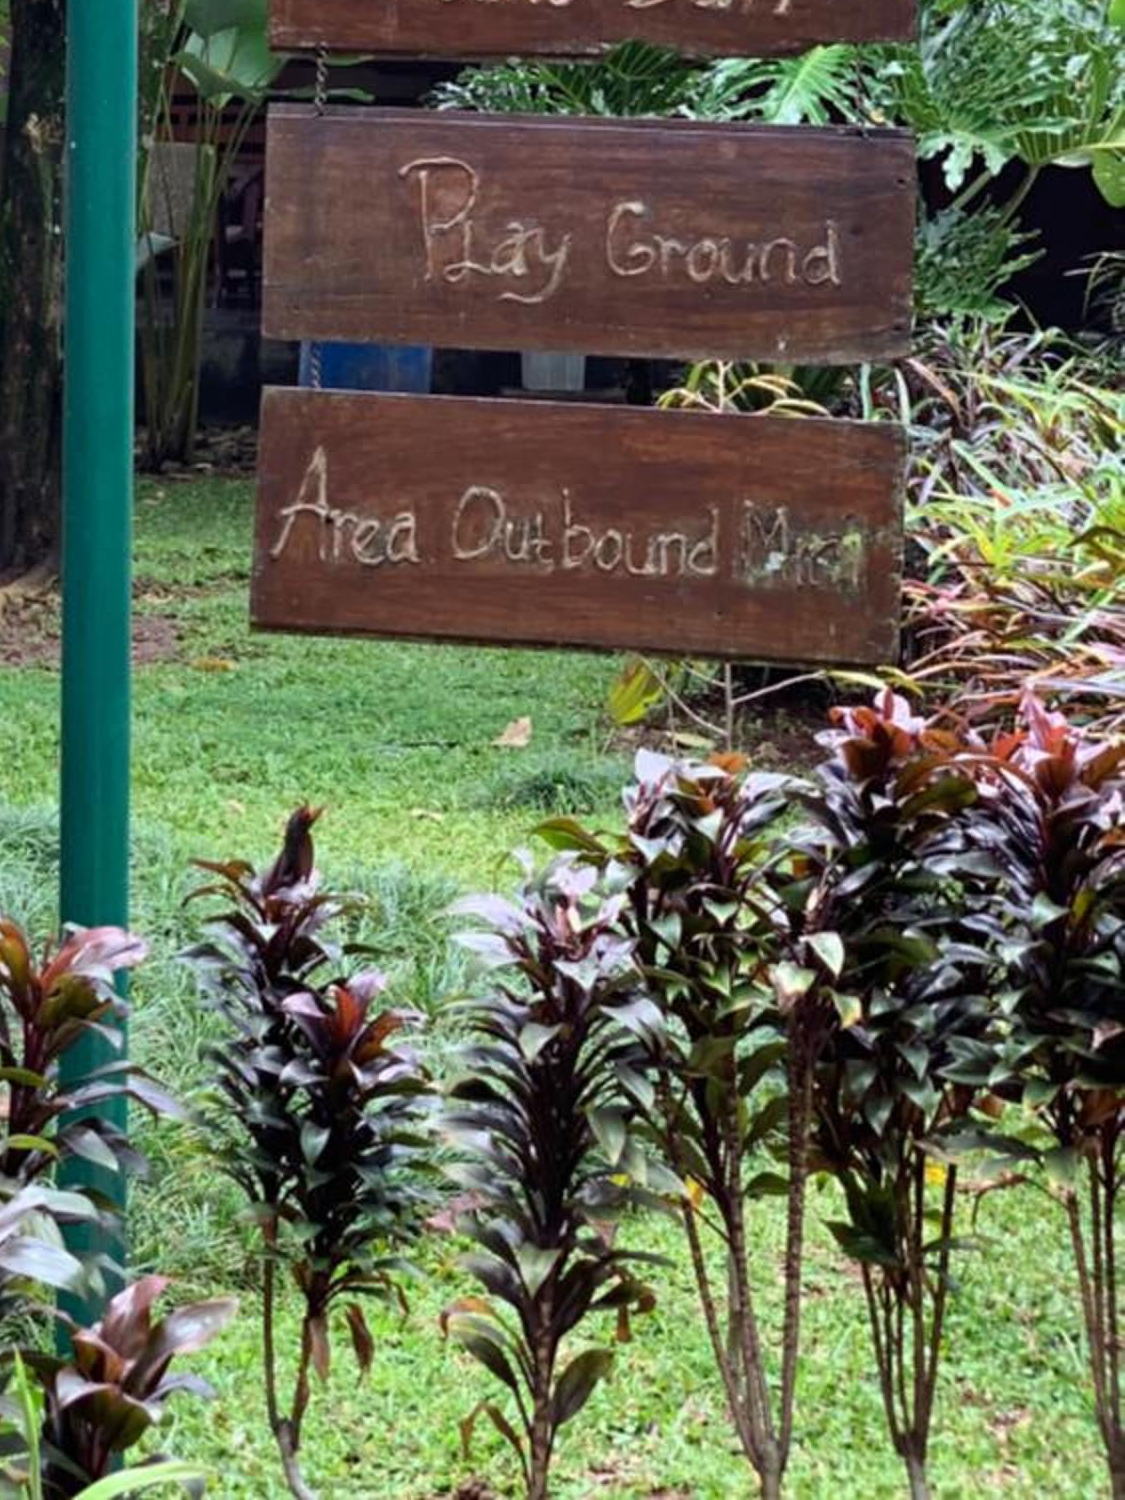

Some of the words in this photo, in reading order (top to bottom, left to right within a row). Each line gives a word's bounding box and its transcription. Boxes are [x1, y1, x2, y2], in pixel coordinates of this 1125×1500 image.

[606, 200, 841, 287] Ground
[271, 445, 421, 565] Area
[452, 486, 718, 575] Outbound
